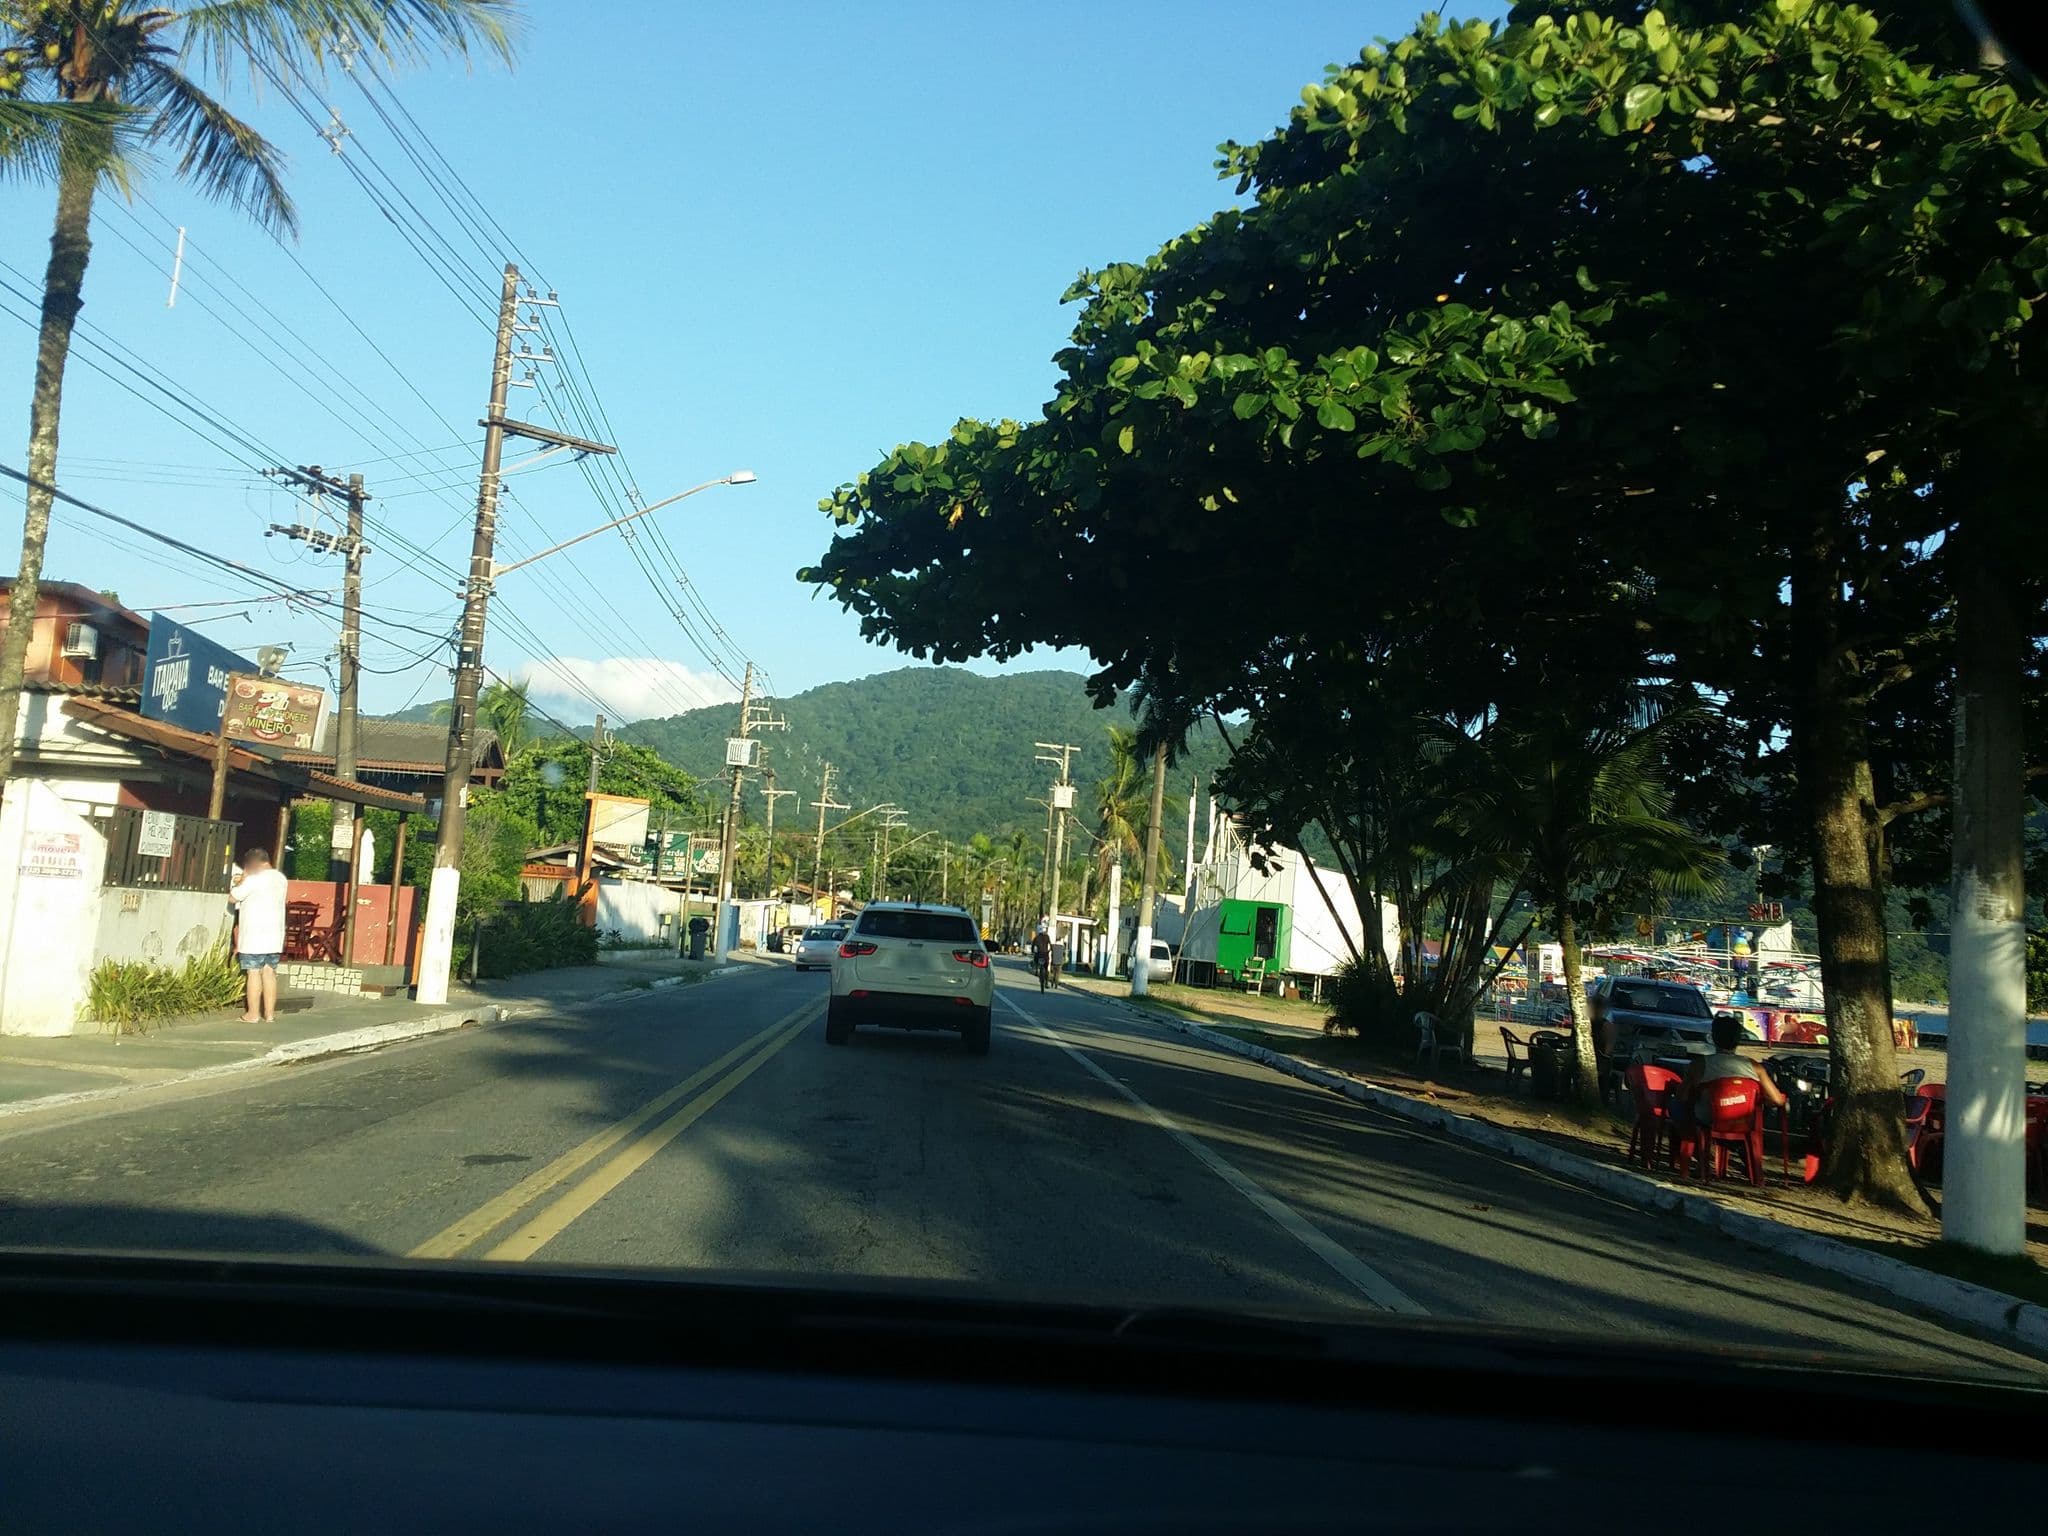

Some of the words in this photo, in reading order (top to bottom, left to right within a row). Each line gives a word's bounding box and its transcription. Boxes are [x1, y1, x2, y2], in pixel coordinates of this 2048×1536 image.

[152, 659, 189, 698] ITAIPAVA
[238, 702, 254, 714] BAR
[245, 717, 293, 735] MINEIRO
[31, 855, 76, 867] ALUGA
